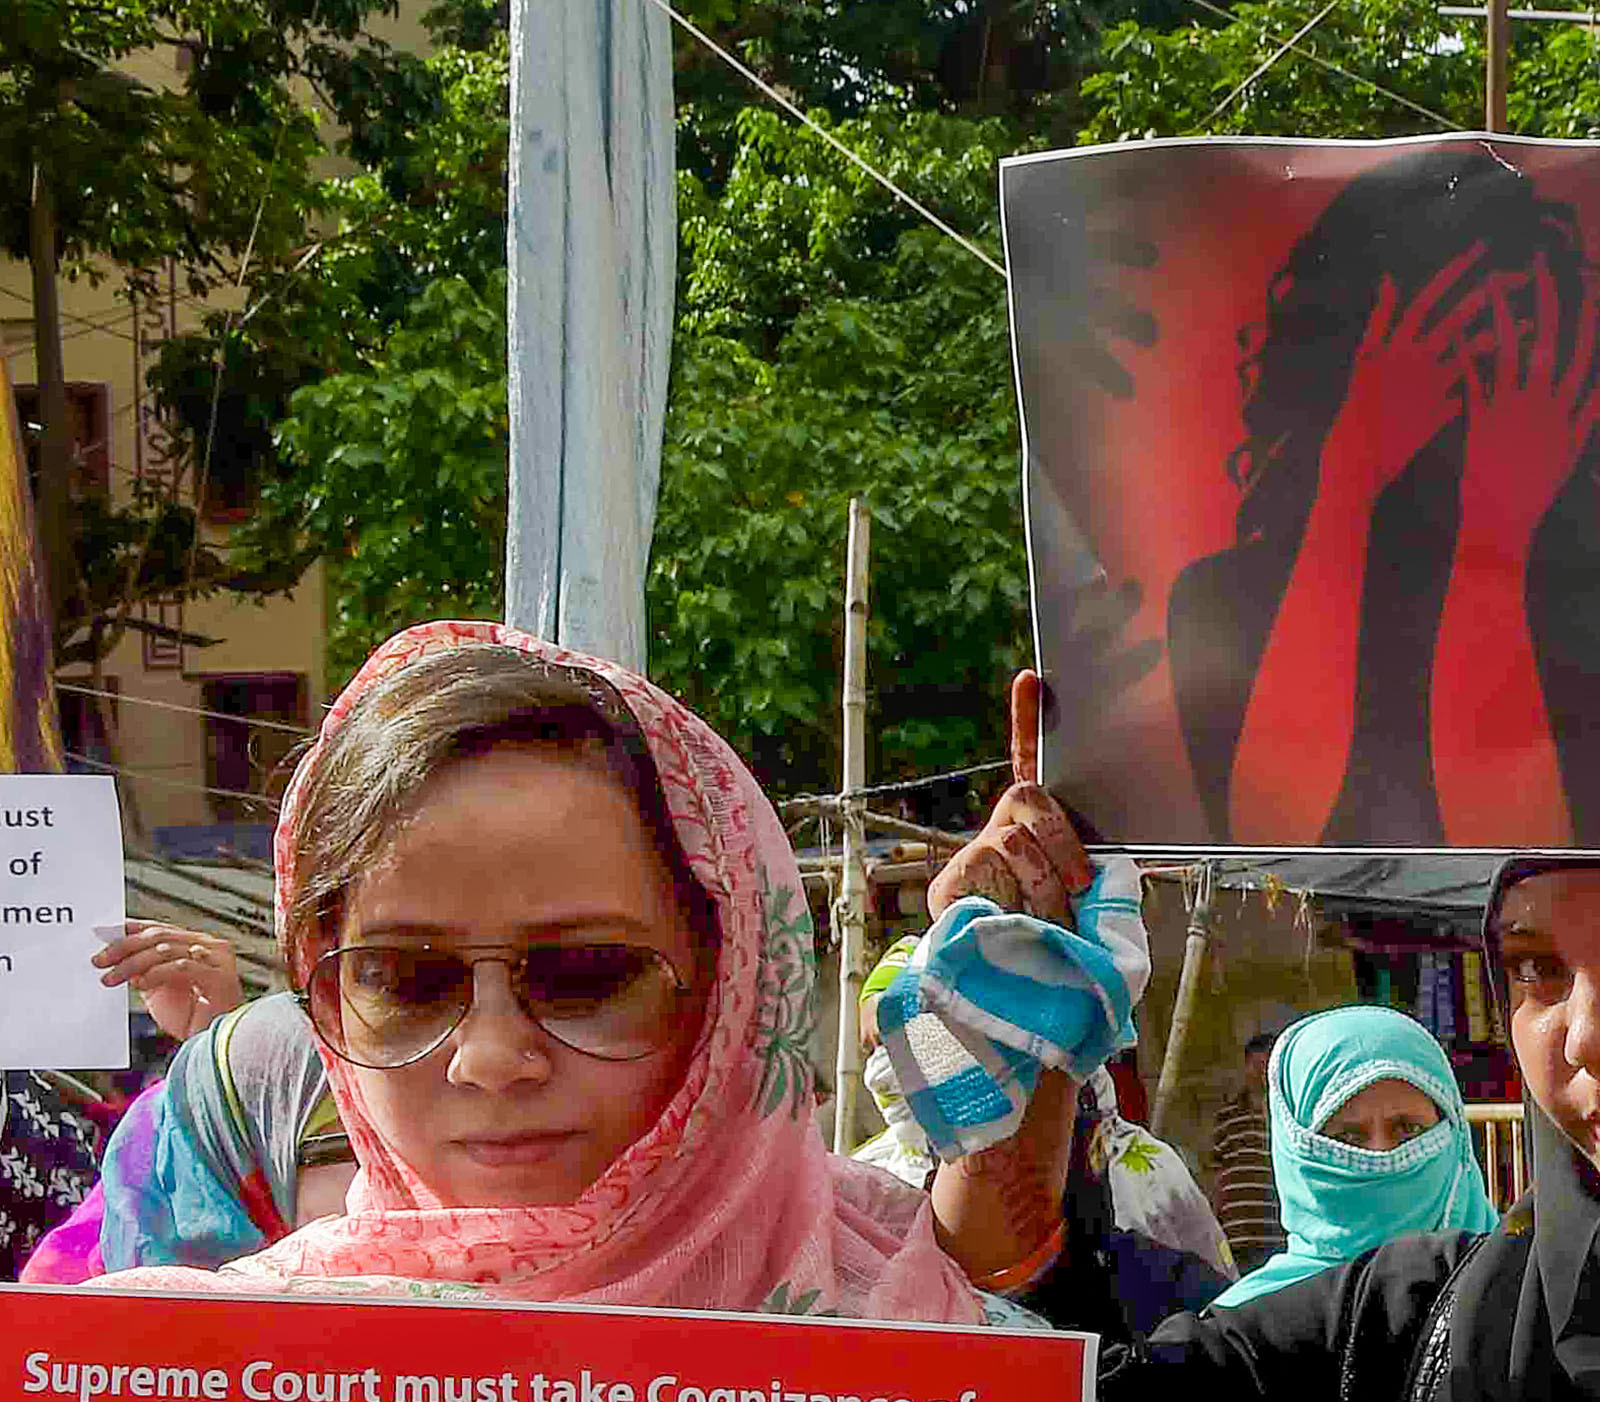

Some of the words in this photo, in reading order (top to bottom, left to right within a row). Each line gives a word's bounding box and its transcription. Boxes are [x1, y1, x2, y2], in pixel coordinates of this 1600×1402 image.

[0, 806, 54, 828] ust
[9, 851, 43, 875] of
[3, 905, 73, 924] men
[242, 1361, 381, 1402] Court
